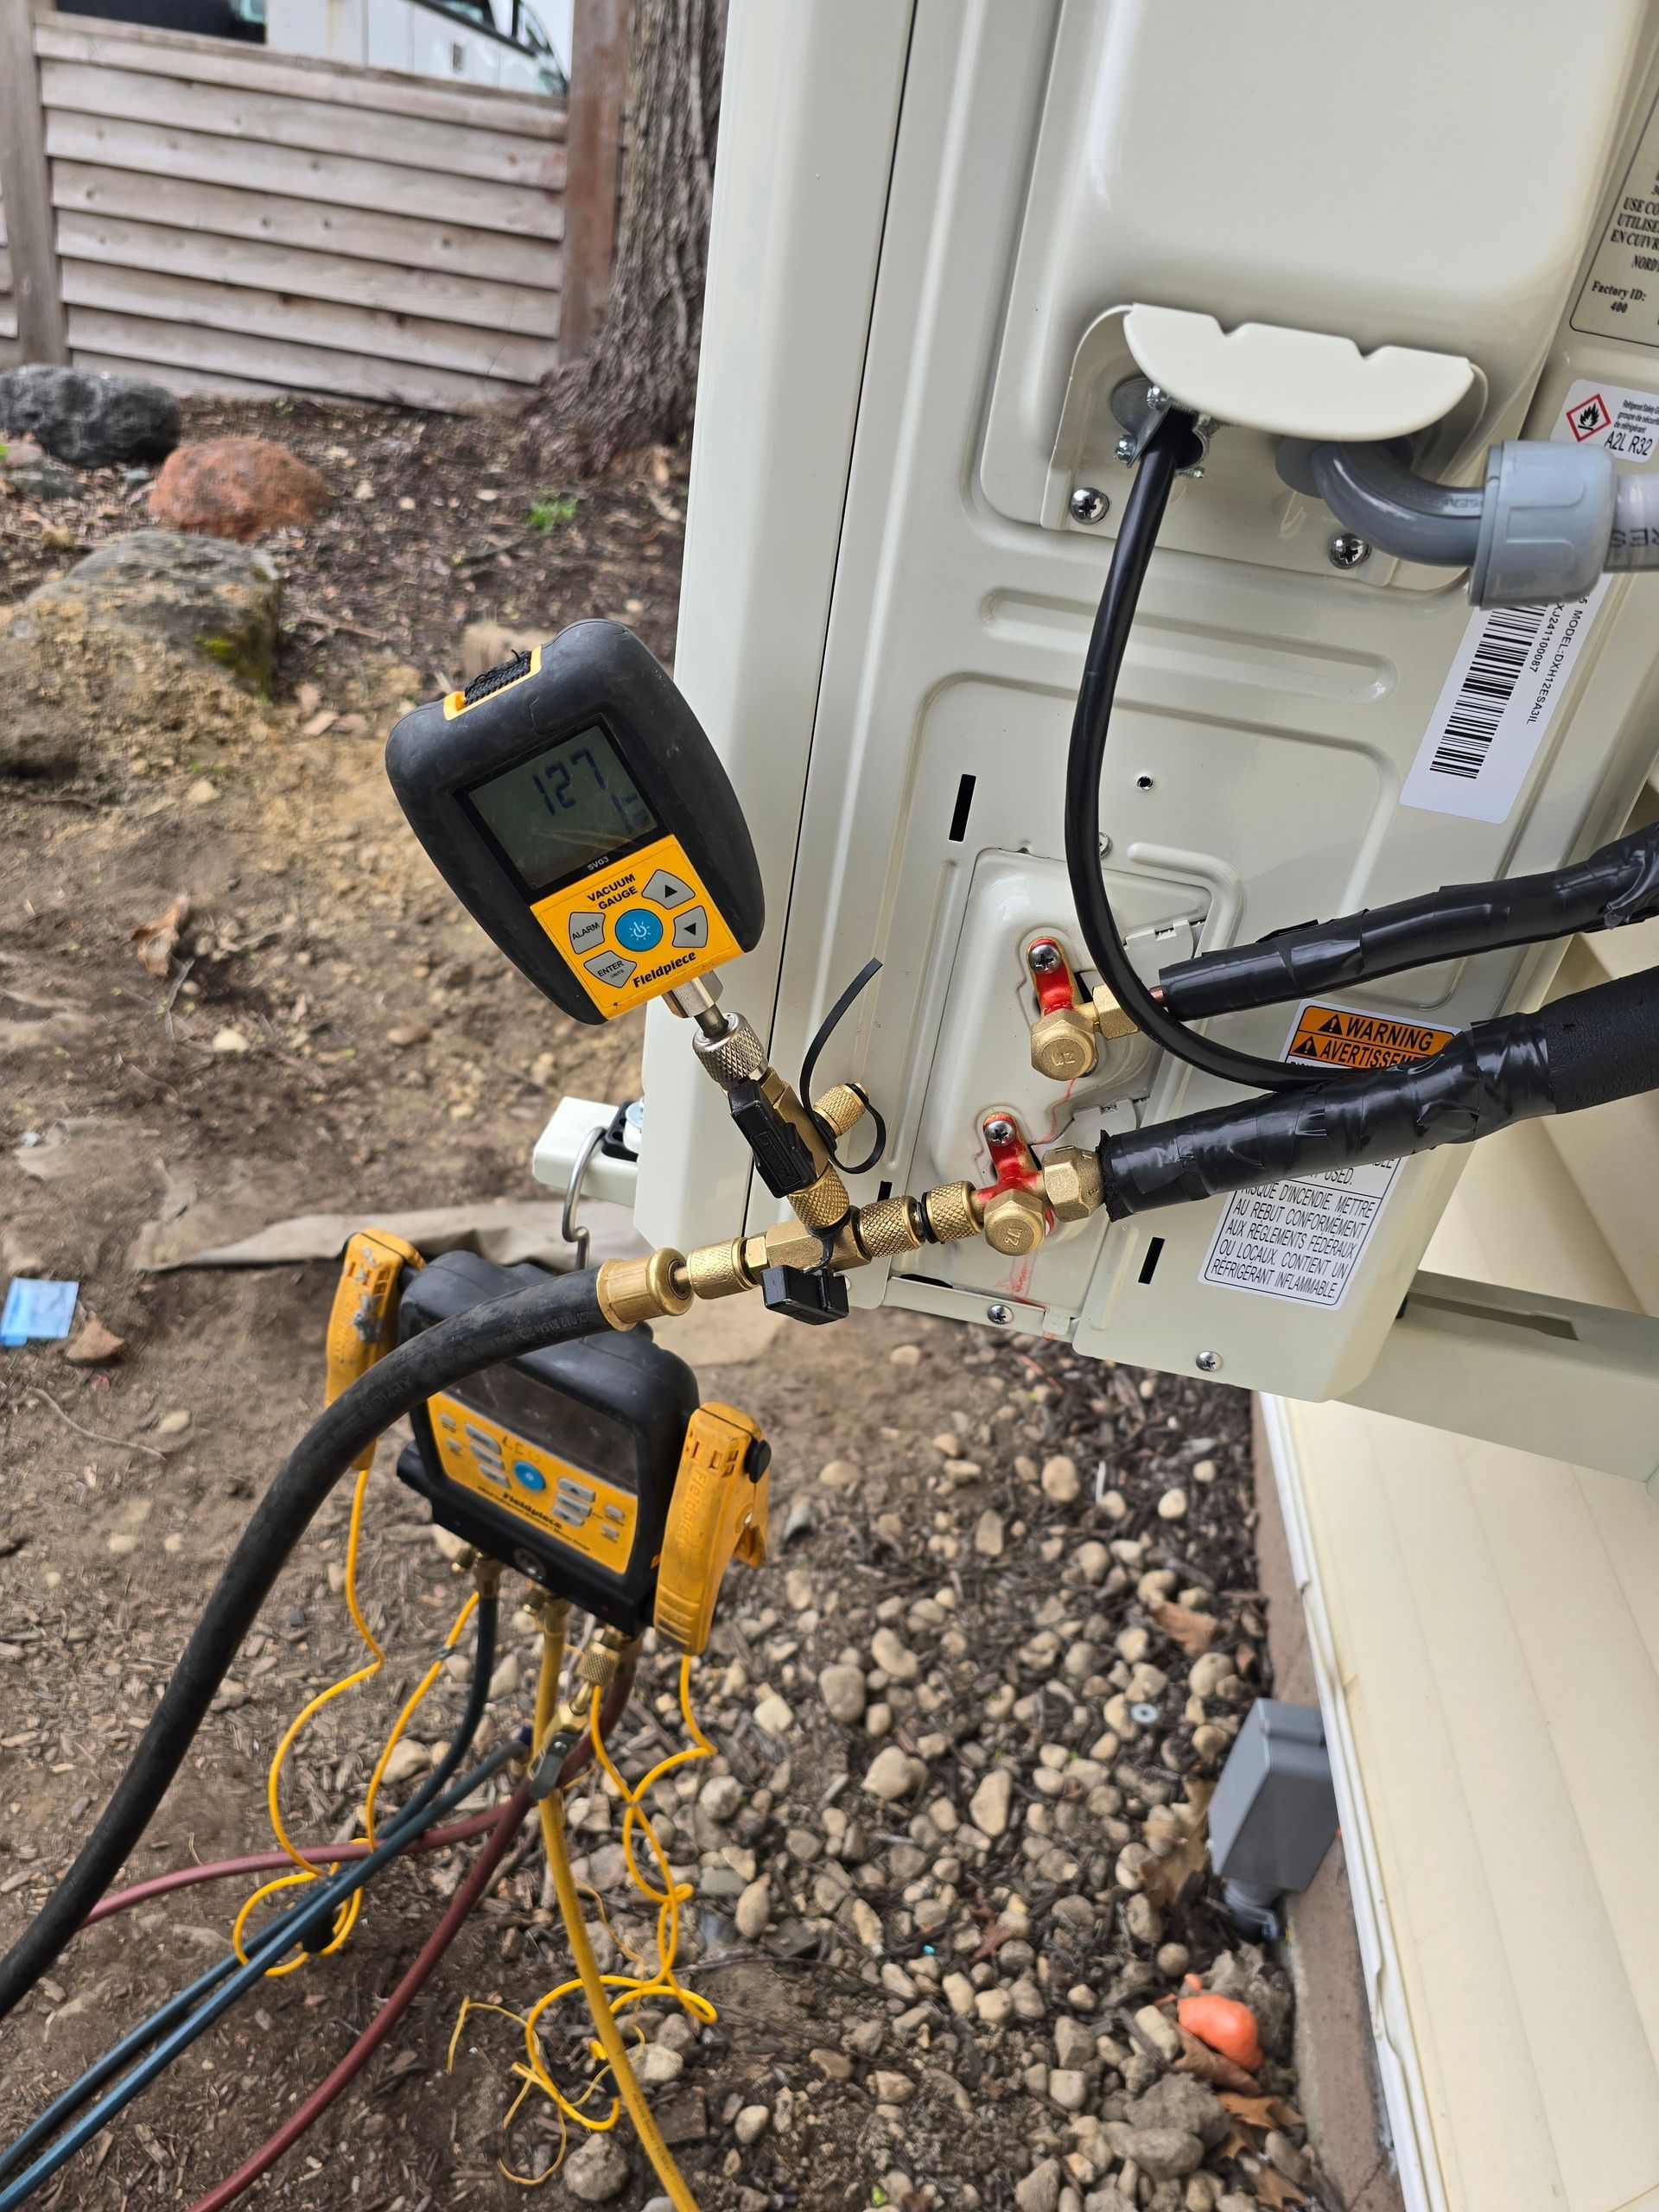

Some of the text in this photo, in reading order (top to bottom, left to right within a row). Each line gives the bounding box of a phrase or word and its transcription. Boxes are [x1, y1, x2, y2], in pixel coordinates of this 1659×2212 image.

[1624, 196, 1645, 213] USE
[1611, 229, 1627, 243] EN
[1592, 281, 1646, 302] Factory ID:
[1610, 301, 1628, 313] 400
[1604, 431, 1653, 455] A2L R32
[532, 748, 606, 816] 127
[588, 856, 610, 872] SVG3
[587, 874, 636, 902] VACUUM
[598, 886, 638, 910] GAUGE
[572, 922, 600, 941] ALARM
[597, 960, 624, 977] ENTER
[632, 951, 696, 988] Fieldpiece
[1346, 1017, 1434, 1052] WARNING
[1279, 1185, 1332, 1211] D'INCENDIE.
[1334, 1196, 1376, 1218] METTRE
[1233, 1198, 1366, 1239] AU REBUT CONFORMÉMENT
[1225, 1218, 1357, 1260] AUX RÈGLEMENTS FÉDÉRAUX
[1219, 1239, 1349, 1280] OU LOCAUX. CONTIENT UN
[1211, 1255, 1338, 1299] RÉFRIGÉRANT INFLAMMABLE.
[503, 1492, 563, 1529] Fieldpiece
